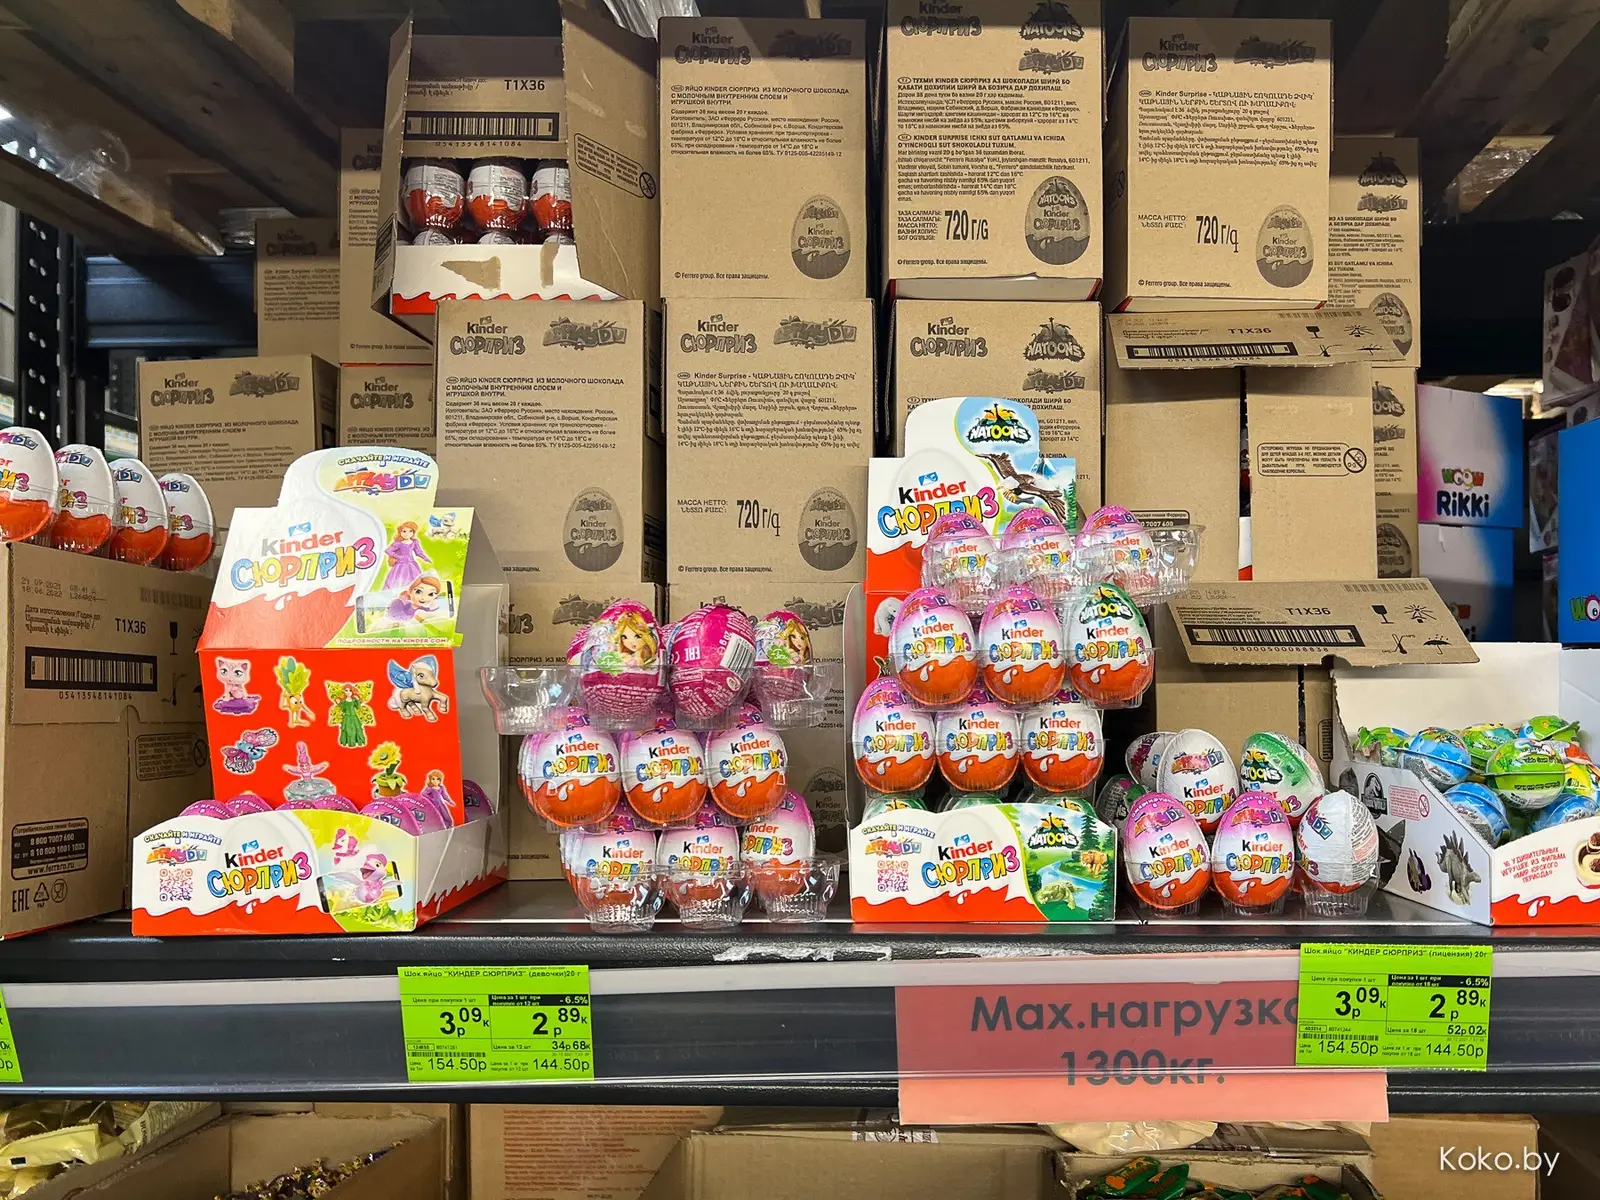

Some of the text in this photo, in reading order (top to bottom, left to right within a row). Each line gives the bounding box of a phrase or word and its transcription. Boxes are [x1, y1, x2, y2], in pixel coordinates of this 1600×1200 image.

[692, 31, 733, 45] Kinder
[1159, 39, 1200, 52] Kinder
[504, 78, 545, 91] T1X36
[944, 210, 969, 241] 720
[1138, 214, 1188, 223] МАССА НЕТТО:
[467, 321, 508, 334] Kinder
[697, 320, 739, 332] Kinder
[928, 323, 969, 336] Kinder
[1228, 327, 1273, 335] T1X36
[969, 426, 1032, 444] NATOONS
[338, 454, 384, 466] СКАЧАЙТЕ
[392, 455, 431, 469] ИГРАЙТЕ
[898, 479, 967, 505] Kinder
[1437, 490, 1489, 518] Rikki
[260, 529, 344, 558] Kinder
[230, 537, 377, 591] СЮРПРИЗ
[1285, 606, 1332, 617] T1X36
[115, 618, 146, 634] T1X36
[912, 622, 955, 636] Kinder
[1001, 626, 1044, 640] Kinder
[1086, 625, 1129, 640] Kinder
[875, 720, 916, 732] Kinder
[958, 718, 1000, 731] Kinder
[1040, 718, 1081, 730] Kinder
[556, 742, 600, 757] Kinder
[648, 744, 691, 759] Kinder
[730, 738, 771, 754] Kinder
[1184, 784, 1224, 798] Kinder
[144, 830, 182, 843] СКАЧАЙТЕ
[189, 831, 223, 846] ИГРАЙТЕ
[1028, 832, 1080, 849] NATOONS
[683, 841, 724, 855] Kinder
[938, 839, 993, 861] Kinder
[1149, 839, 1191, 859] Kinder
[1242, 840, 1284, 853] Kinder
[225, 846, 284, 869] Kinder
[1511, 847, 1559, 864] УДИВИТЕЛЬНЫХ
[207, 851, 312, 898] СЮРПРИЗ
[920, 845, 1020, 889] СЮРПРИЗ
[1501, 861, 1528, 877] ИГРУШЕК
[1531, 861, 1559, 873] ЮРСКОГО
[12, 888, 30, 913] EAC
[1318, 1040, 1379, 1056] 154.50р
[1425, 1043, 1484, 1058] 144.50р
[428, 1058, 487, 1072] 154.50р
[533, 1058, 590, 1072] 144.50р
[1060, 1050, 1225, 1087] 1300кг.
